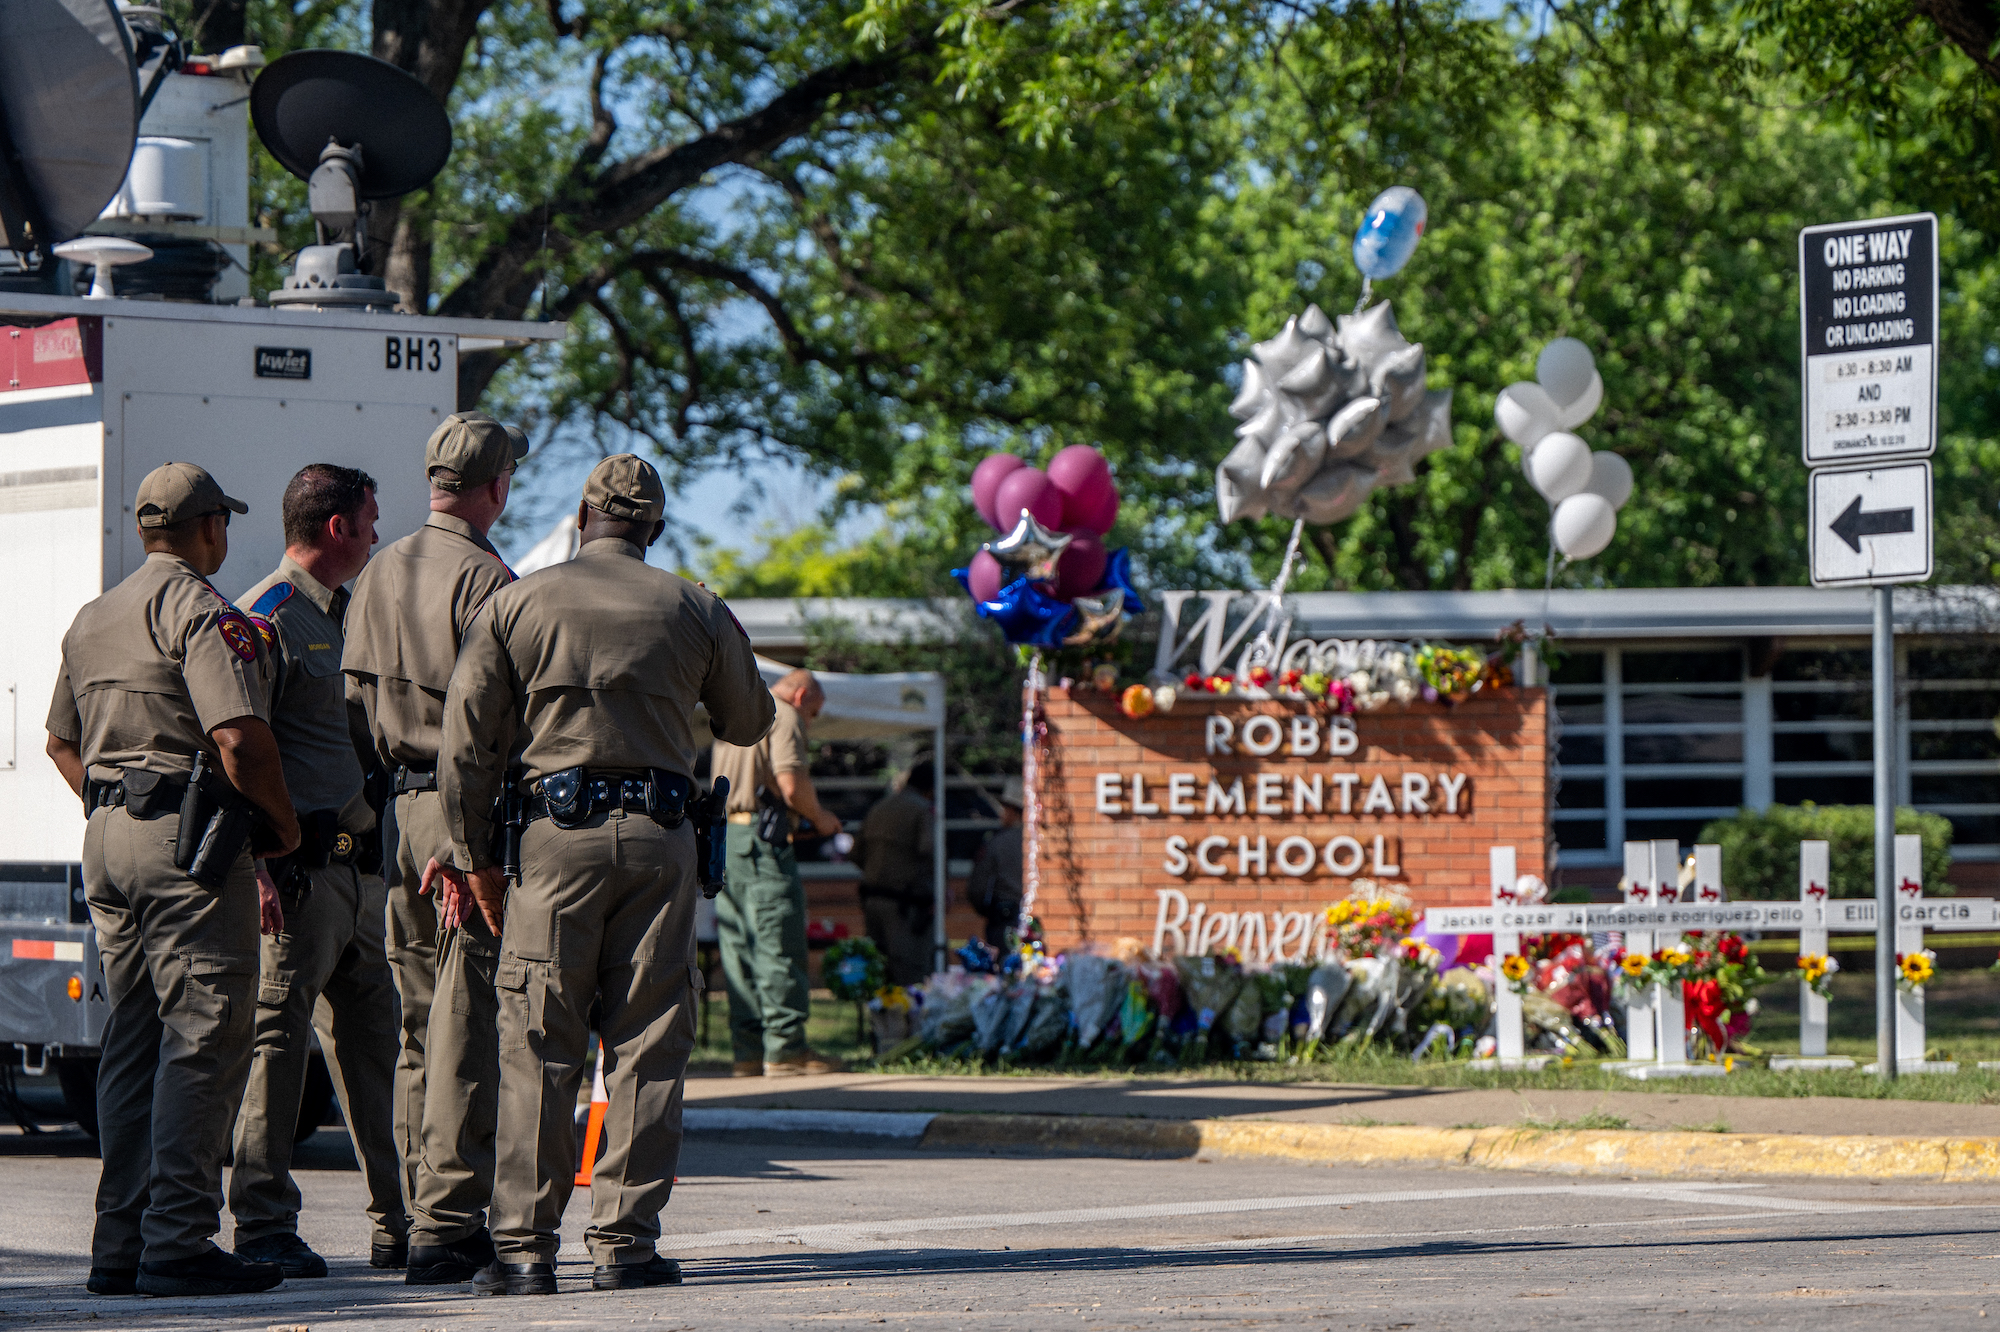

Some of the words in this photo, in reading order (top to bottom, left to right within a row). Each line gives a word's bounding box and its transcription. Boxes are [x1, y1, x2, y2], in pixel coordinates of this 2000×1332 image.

[1823, 234, 1866, 268] ONE
[1868, 229, 1913, 262] WAY
[1833, 269, 1852, 291] NO
[1852, 263, 1906, 289] PARKING
[1833, 296, 1852, 319] NO
[1853, 290, 1907, 317] LOADING
[1825, 325, 1845, 347] OR
[1845, 318, 1914, 346] UNLOADING
[386, 336, 441, 372] BH3
[1895, 355, 1912, 373] AM
[1858, 383, 1882, 402] AND
[1835, 412, 1859, 428] 2:30
[1894, 406, 1911, 423] PM
[1205, 715, 1361, 756] ROBB
[1095, 772, 1467, 815] ELEMENTARY
[1163, 834, 1400, 876] SCHOOL
[1672, 907, 1752, 924] Rodriguez
[1900, 904, 1970, 920] Garcia
